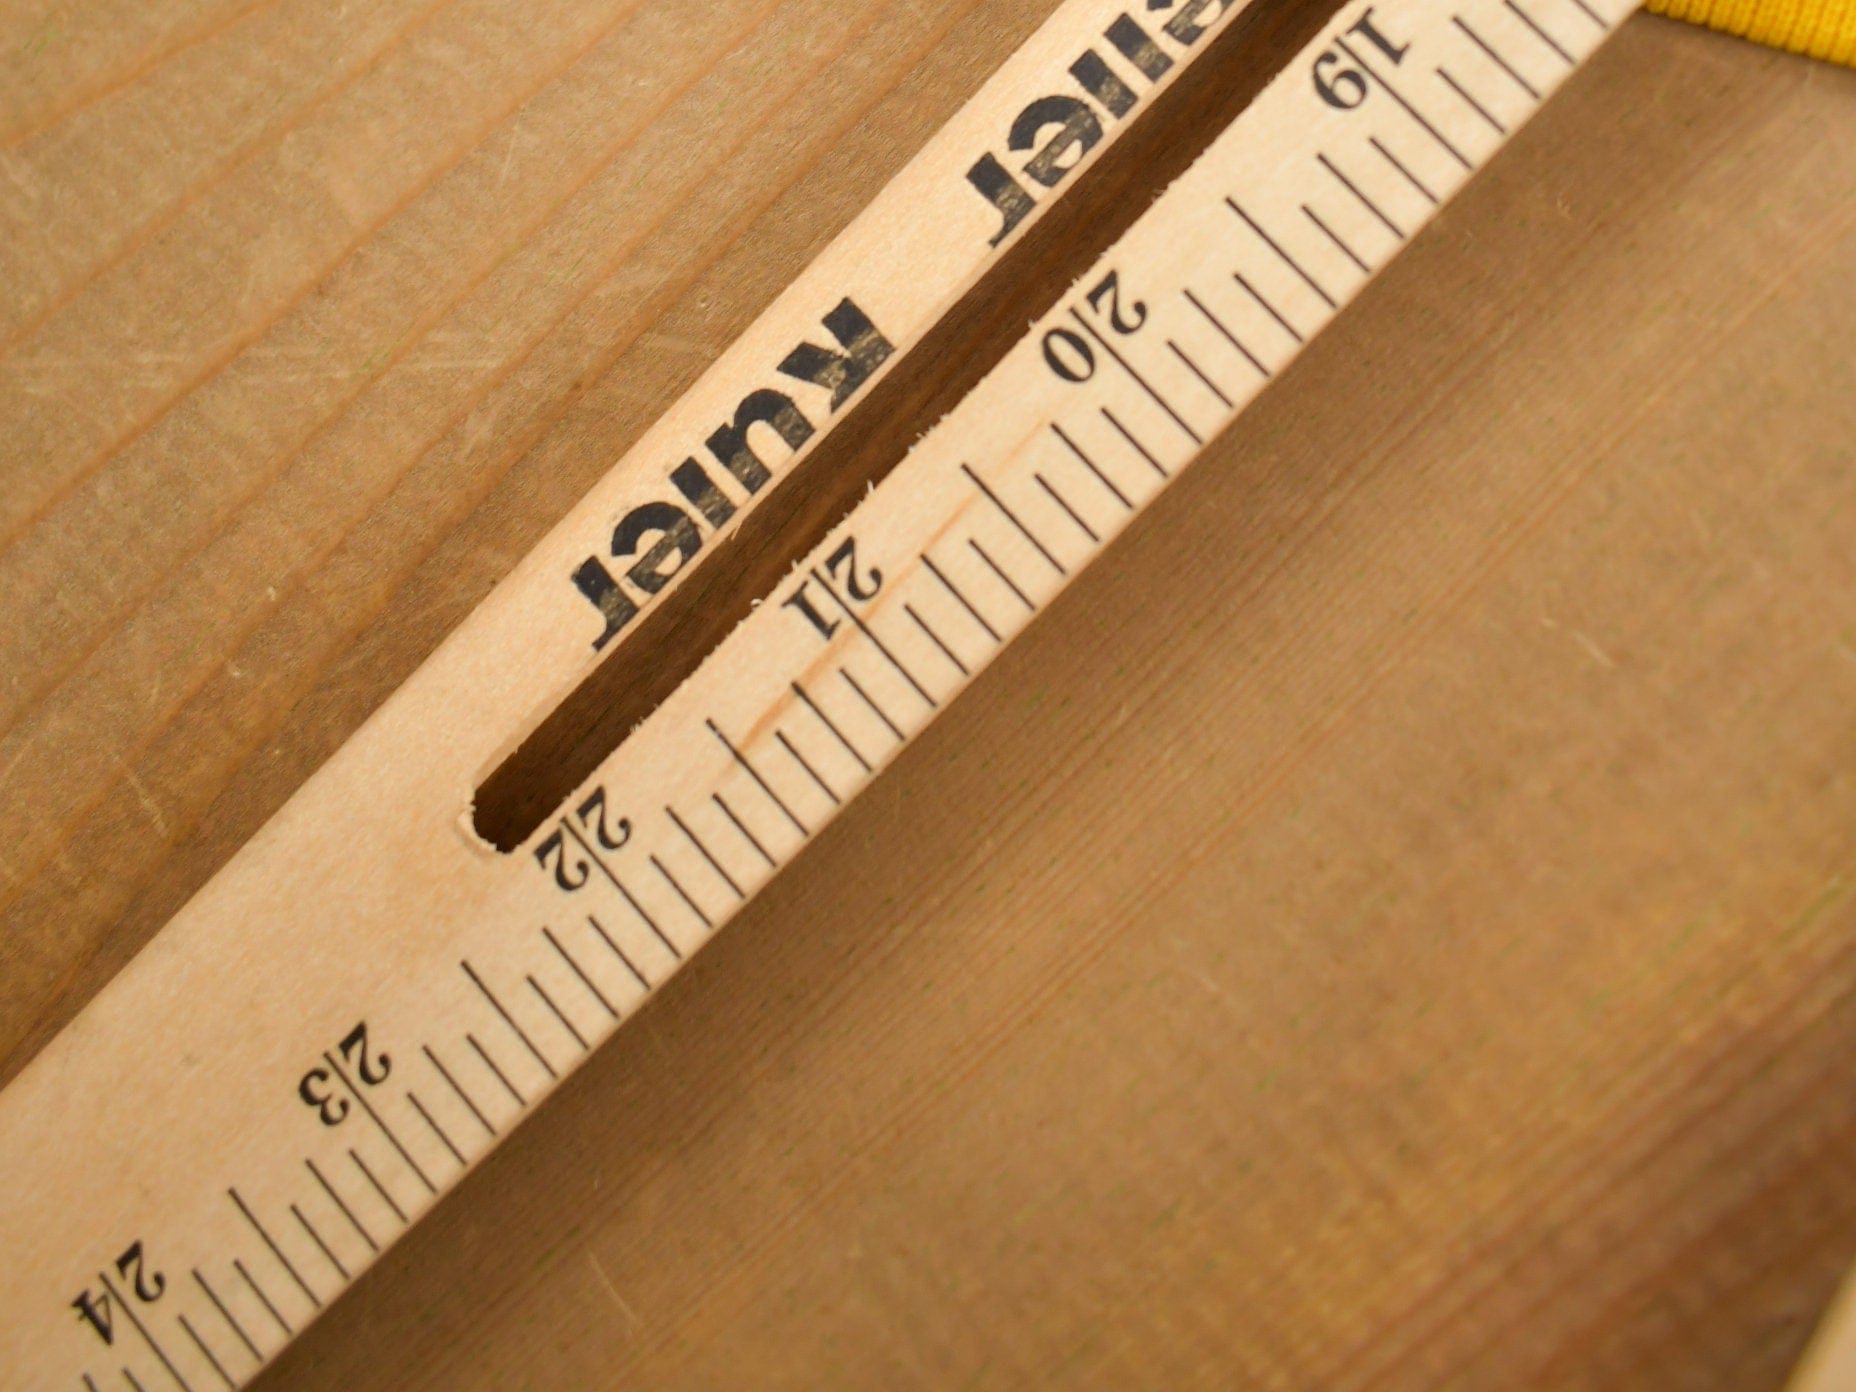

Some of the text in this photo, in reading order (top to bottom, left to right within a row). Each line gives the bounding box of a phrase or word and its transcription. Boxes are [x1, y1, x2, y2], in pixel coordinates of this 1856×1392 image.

[1312, 6, 1411, 110] 19
[1042, 270, 1147, 383] 20
[781, 536, 882, 641] 21
[534, 786, 632, 892] 22
[298, 1021, 392, 1127] 23
[71, 1239, 166, 1347] 24
